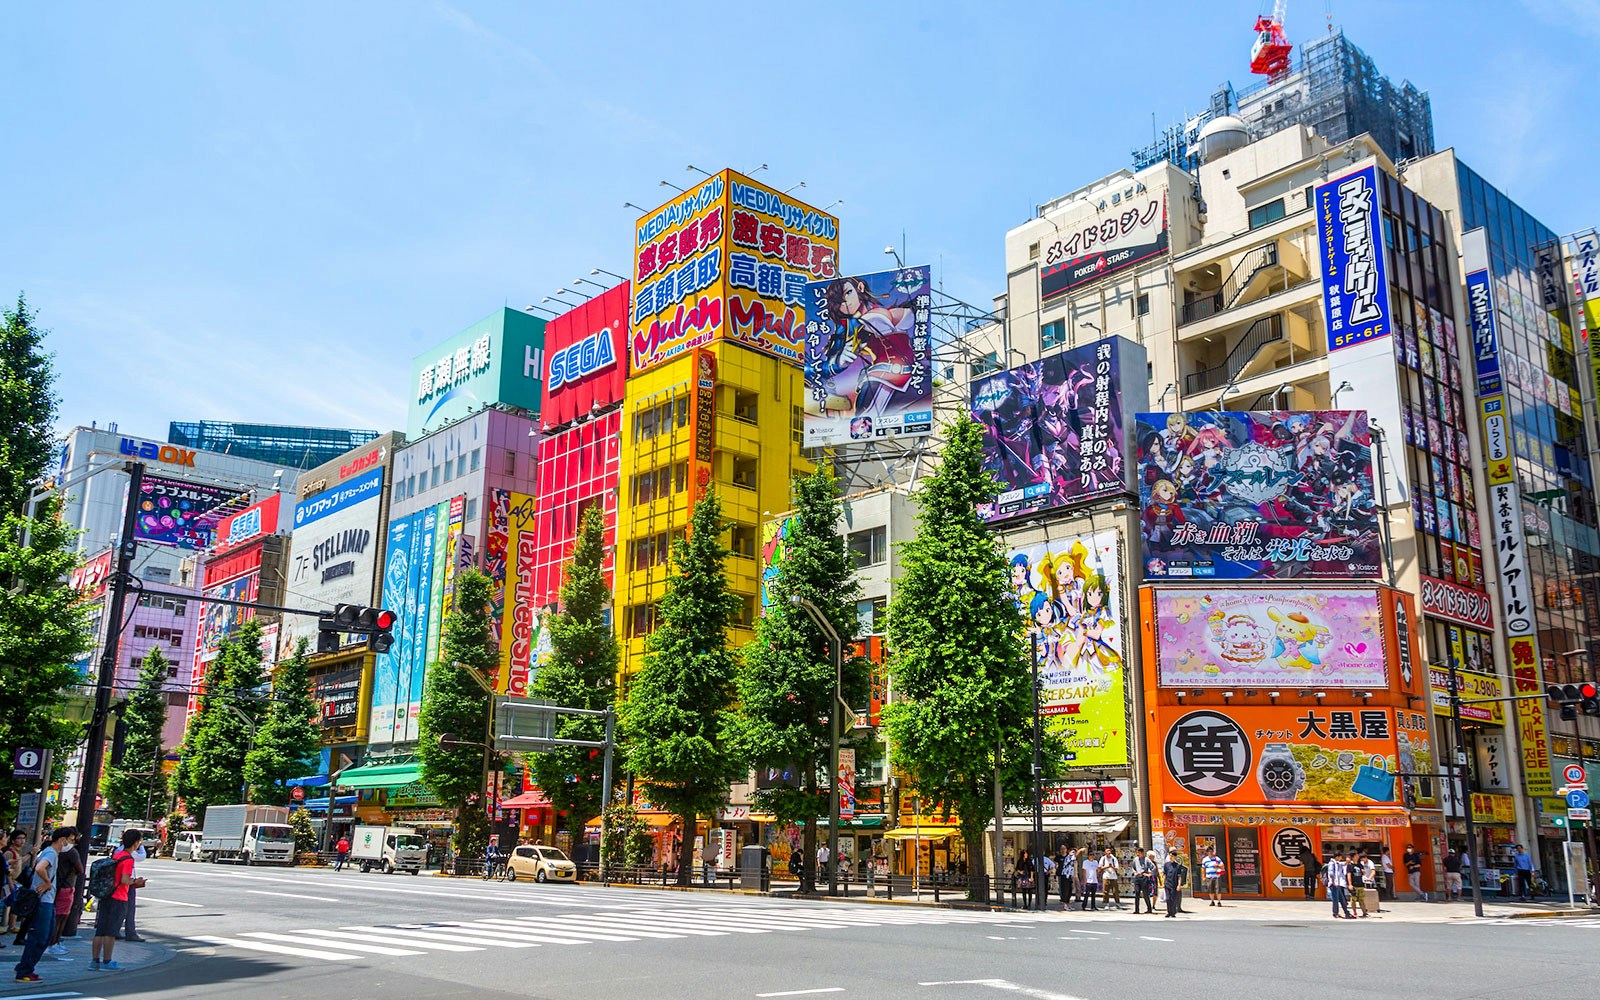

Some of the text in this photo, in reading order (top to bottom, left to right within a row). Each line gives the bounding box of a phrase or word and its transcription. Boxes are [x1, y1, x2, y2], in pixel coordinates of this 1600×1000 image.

[638, 177, 723, 246] MEDIAリサイクル
[731, 181, 836, 240] MEDIAリサイクル
[637, 207, 722, 281] 激安販売
[731, 211, 837, 278] 激安販売
[1046, 200, 1158, 264] メイドカジノ
[634, 247, 721, 325] 高額買取
[730, 252, 806, 306] 高額買
[1074, 263, 1096, 278] POKER
[728, 295, 805, 340] Mula
[814, 287, 830, 334] いつでも
[1328, 285, 1343, 331] 秋葉原店
[632, 297, 723, 367] Mulan
[740, 332, 773, 350] ムーラン
[773, 344, 797, 358] AKIBA
[911, 295, 930, 395] 準備は整ったぞ。
[548, 327, 617, 391] SEGA
[641, 352, 666, 369] ムーラン
[666, 345, 685, 358] AKIBA
[1093, 344, 1112, 471] 我の射程内にのみ
[1487, 401, 1499, 411] 3F
[1079, 425, 1094, 488] 真理あり
[1490, 418, 1502, 458] りらくる
[339, 449, 379, 479] ビックカメラ
[306, 492, 340, 517] ソフマップ
[295, 556, 309, 582] 7F
[313, 528, 370, 570] STELLAMAP
[1423, 581, 1490, 623] メイドカジノ
[1511, 641, 1538, 692] 免税
[1044, 686, 1098, 701] VERSARY
[1062, 717, 1075, 726] 7.15
[1256, 729, 1293, 739] チケット
[1297, 710, 1390, 740] 大黒屋
[1175, 724, 1243, 785] 質
[1488, 745, 1501, 786] ルノアール
[1535, 730, 1548, 768] FREE
[1569, 770, 1580, 779] 40
[719, 807, 746, 818] ラーメン
[1277, 833, 1306, 862] 質
[1280, 878, 1306, 887] 個室完
